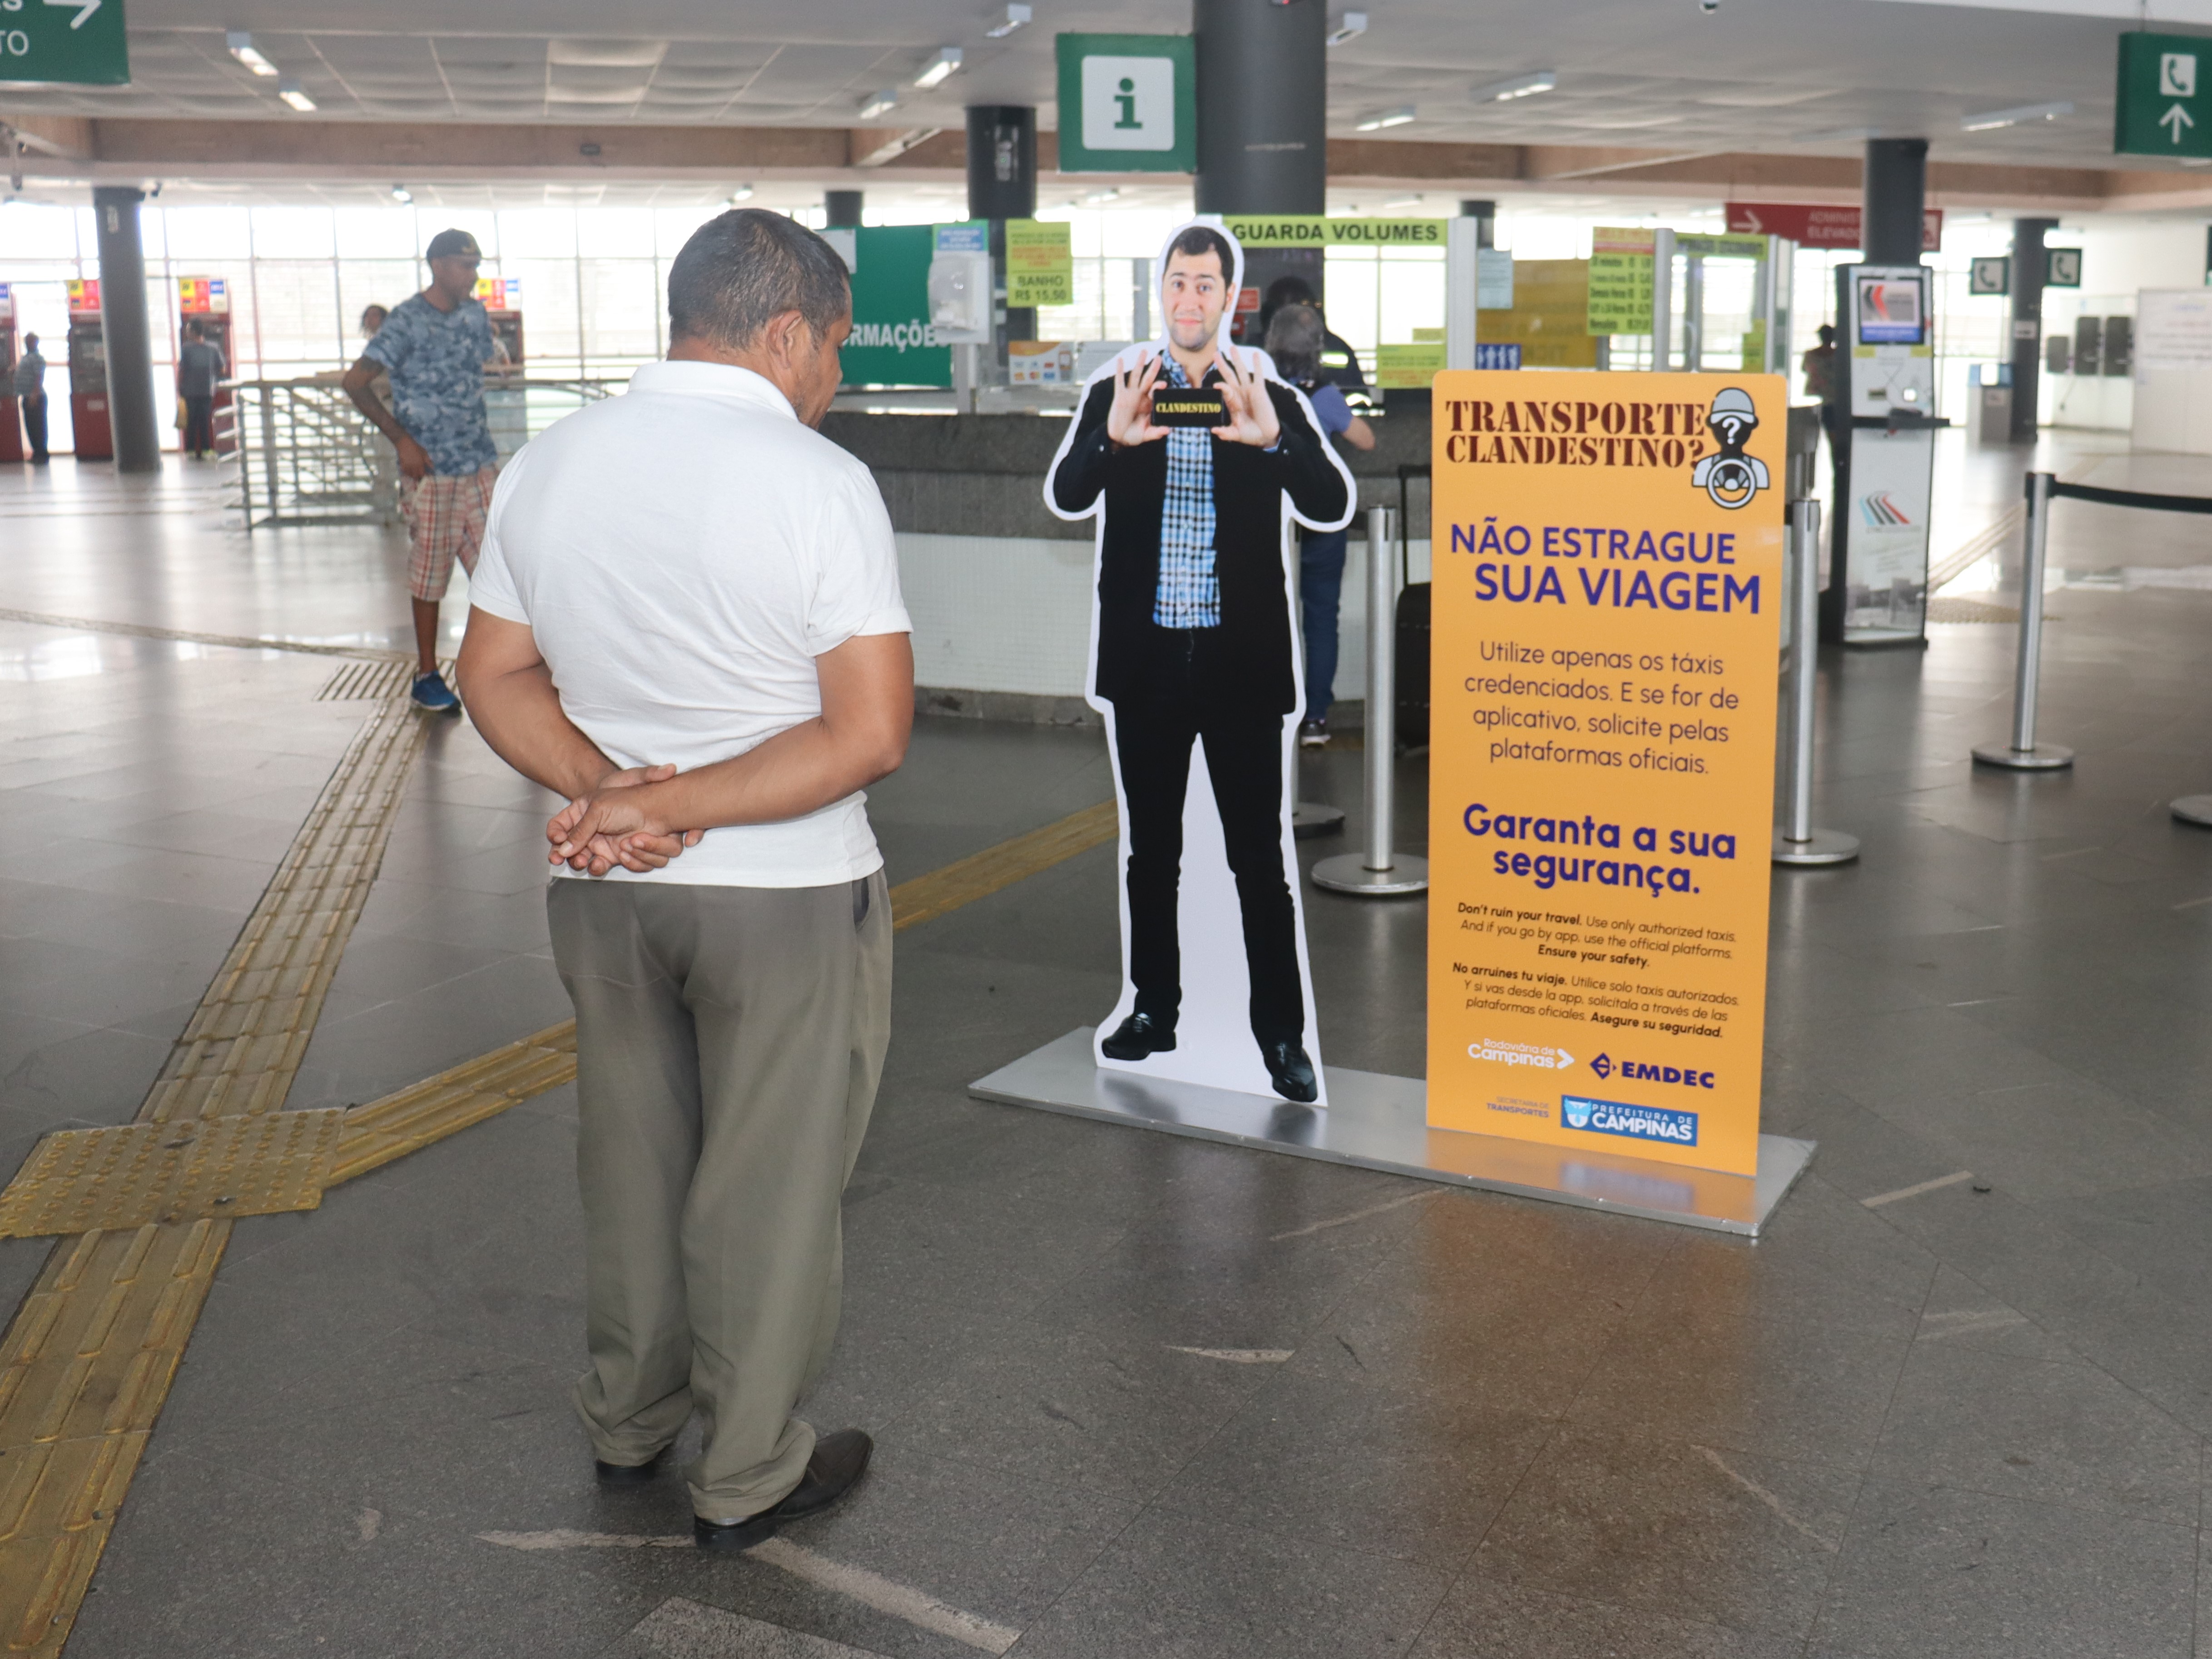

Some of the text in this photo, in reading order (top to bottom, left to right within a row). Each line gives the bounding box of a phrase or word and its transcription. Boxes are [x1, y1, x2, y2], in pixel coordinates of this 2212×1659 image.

[1232, 224, 1438, 241] GUARDA VOLUMES
[1015, 289, 1030, 301] R$
[1018, 275, 1064, 286] BANHO
[1156, 402, 1222, 413] CLANDESTINO
[1446, 401, 1704, 436] TRANSPORTE
[1447, 436, 1704, 470] CLANDESTINO?
[1451, 516, 1736, 565] NÃO ESTRAGUE
[1475, 562, 1760, 614] SUA VIAGEM
[1480, 641, 1724, 675] Utilize apenas os táxis
[1464, 673, 1739, 710] credenciados. E se for de
[1473, 705, 1729, 745] aplicativo, solicite pelas
[1490, 737, 1708, 774] plataformas oficiais.
[1463, 803, 1736, 859] Garanta a sua
[1493, 849, 1700, 898] segurança.
[1458, 902, 1736, 942] Don't ruin your travel. Use only authorized taxis.
[1460, 919, 1484, 932] And
[1486, 921, 1495, 933] if
[1497, 925, 1518, 937] you
[1519, 928, 1535, 940] go
[1537, 927, 1552, 942] by
[1584, 935, 1605, 945] use
[1607, 935, 1627, 948] the
[1629, 937, 1670, 952] official
[1671, 942, 1732, 959] platforms.
[1537, 944, 1650, 969] Ensure your safety.
[1453, 962, 1739, 1006] No arruines tu viaje. Utilice solo taxis autorizados.
[1464, 979, 1472, 990] Y
[1474, 982, 1483, 992] si
[1485, 985, 1505, 995] vas
[1507, 985, 1543, 999] desde
[1545, 988, 1557, 1001] la
[1641, 1003, 1650, 1012] a
[1652, 1003, 1689, 1017] través
[1692, 1007, 1708, 1019] de
[1711, 1008, 1728, 1022] las
[1465, 996, 1722, 1038] plataformas oficiales. Asegure su seguridad.
[1468, 1043, 1555, 1068] Campinas
[1484, 1038, 1555, 1056] Rodoviária de
[1622, 1061, 1715, 1089] EMDEC
[1487, 1103, 1549, 1118] TRANSPORTES
[1592, 1103, 1693, 1125] PREFEITURA DE
[1592, 1112, 1693, 1141] CAMPINAS
